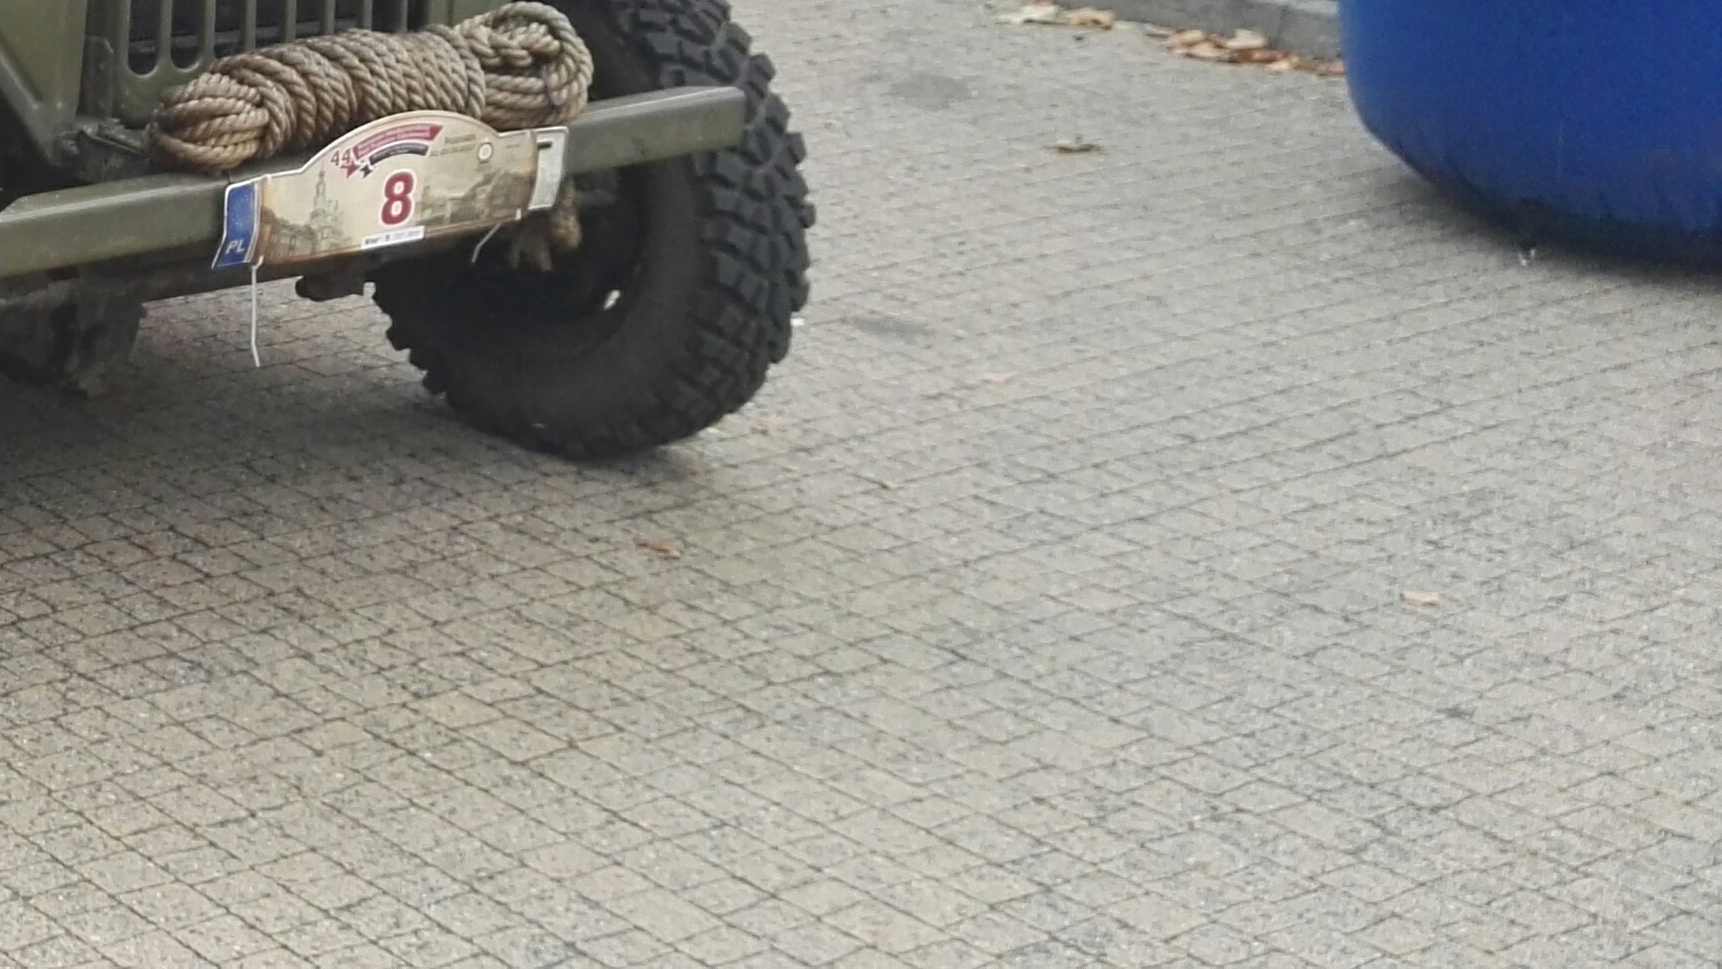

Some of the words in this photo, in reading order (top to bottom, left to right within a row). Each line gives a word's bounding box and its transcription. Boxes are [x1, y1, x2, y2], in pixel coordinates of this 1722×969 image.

[330, 149, 352, 167] 44
[380, 170, 415, 226] 8
[226, 239, 245, 254] PL
